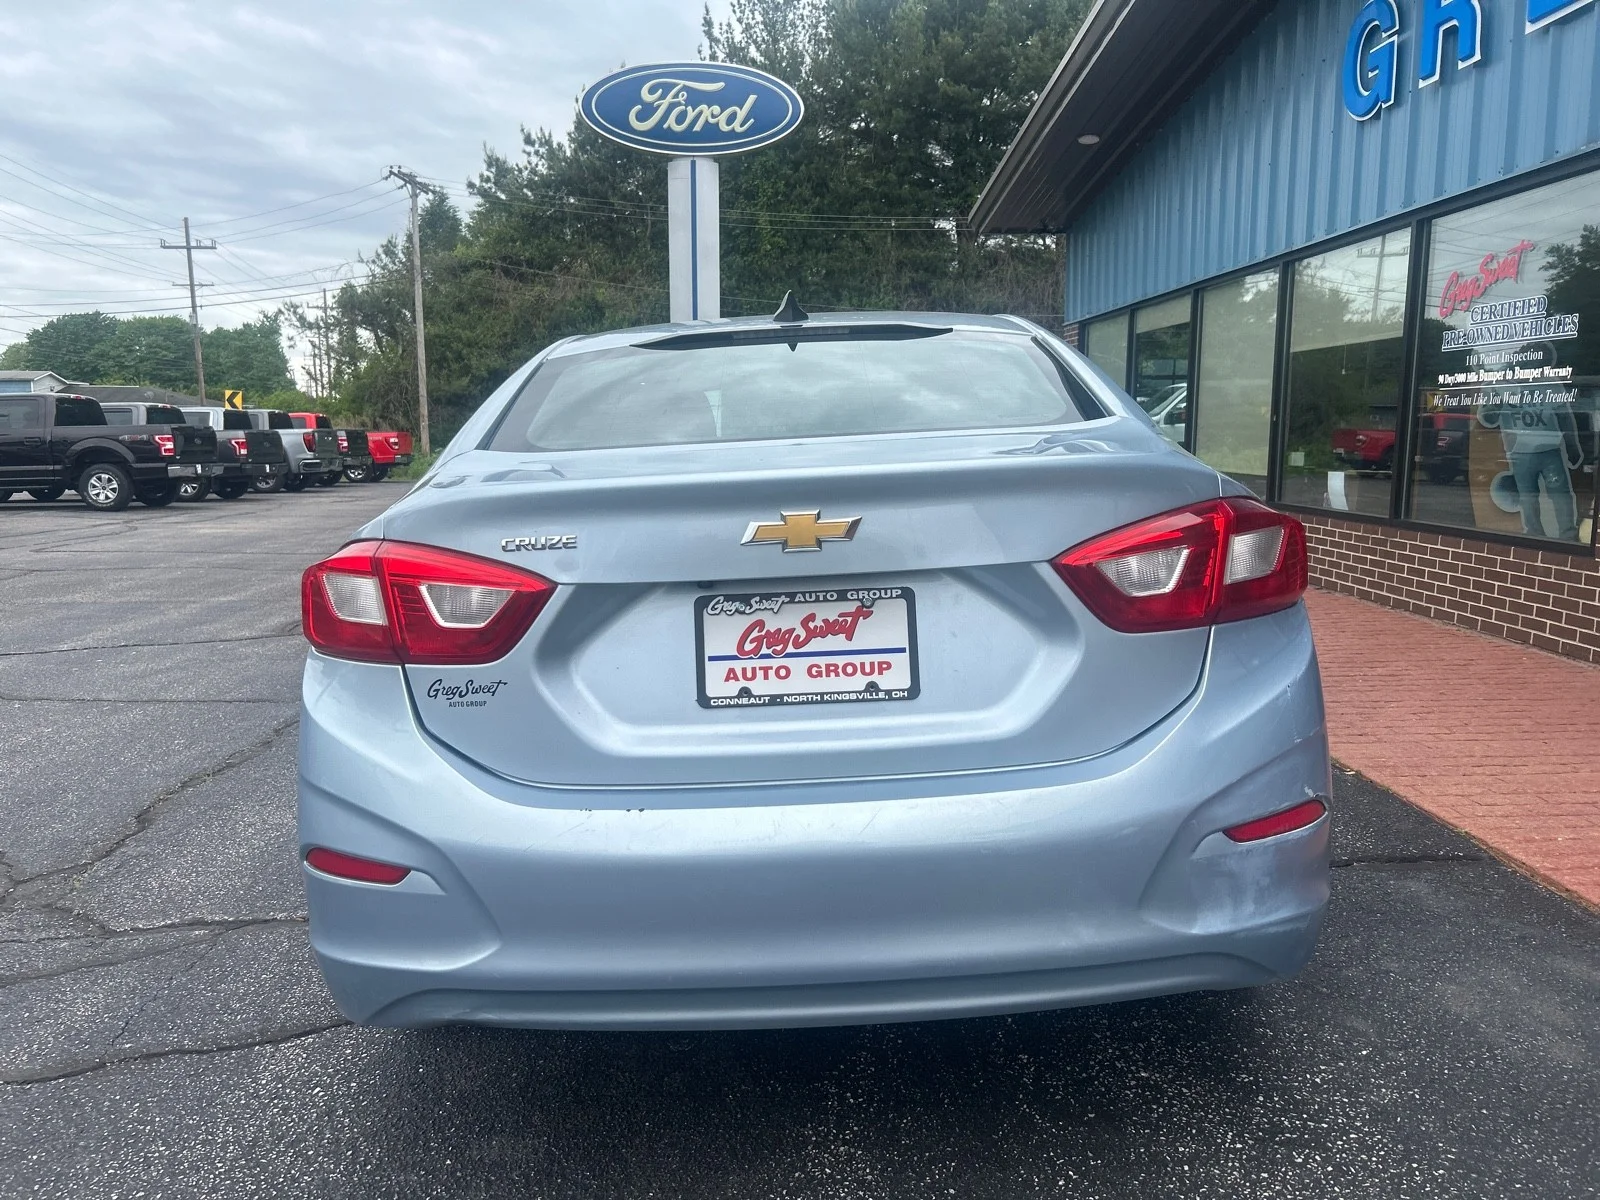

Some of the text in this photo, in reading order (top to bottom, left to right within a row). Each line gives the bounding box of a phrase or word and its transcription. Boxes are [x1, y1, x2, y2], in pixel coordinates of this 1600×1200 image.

[1342, 0, 1593, 121] GR
[628, 78, 758, 133] Ford
[1469, 295, 1548, 323] CERTIFIED
[1442, 313, 1579, 348] PRE-OWNED VEHICLES
[1466, 348, 1543, 366] 110 Point Inspection
[1479, 368, 1505, 385] Bumper
[1505, 367, 1513, 380] to
[1514, 366, 1543, 382] Bumper
[1543, 365, 1573, 379] Warranty
[1433, 388, 1578, 406] We Treat You Like You Want To Be Treated!
[1511, 409, 1547, 428] FOX
[501, 535, 578, 552] CRUZE
[707, 588, 902, 616] Greg Sweet AUTO GROUP
[736, 605, 874, 658] Greg Sweet
[724, 660, 893, 683] AUTO GROUP
[427, 679, 508, 701] Greg Sweet
[710, 696, 771, 706] CONNEAUT
[783, 693, 821, 703] NORTH
[823, 690, 889, 701] KINGSVILLE,
[891, 690, 908, 698] OH
[465, 700, 487, 708] GROUP
